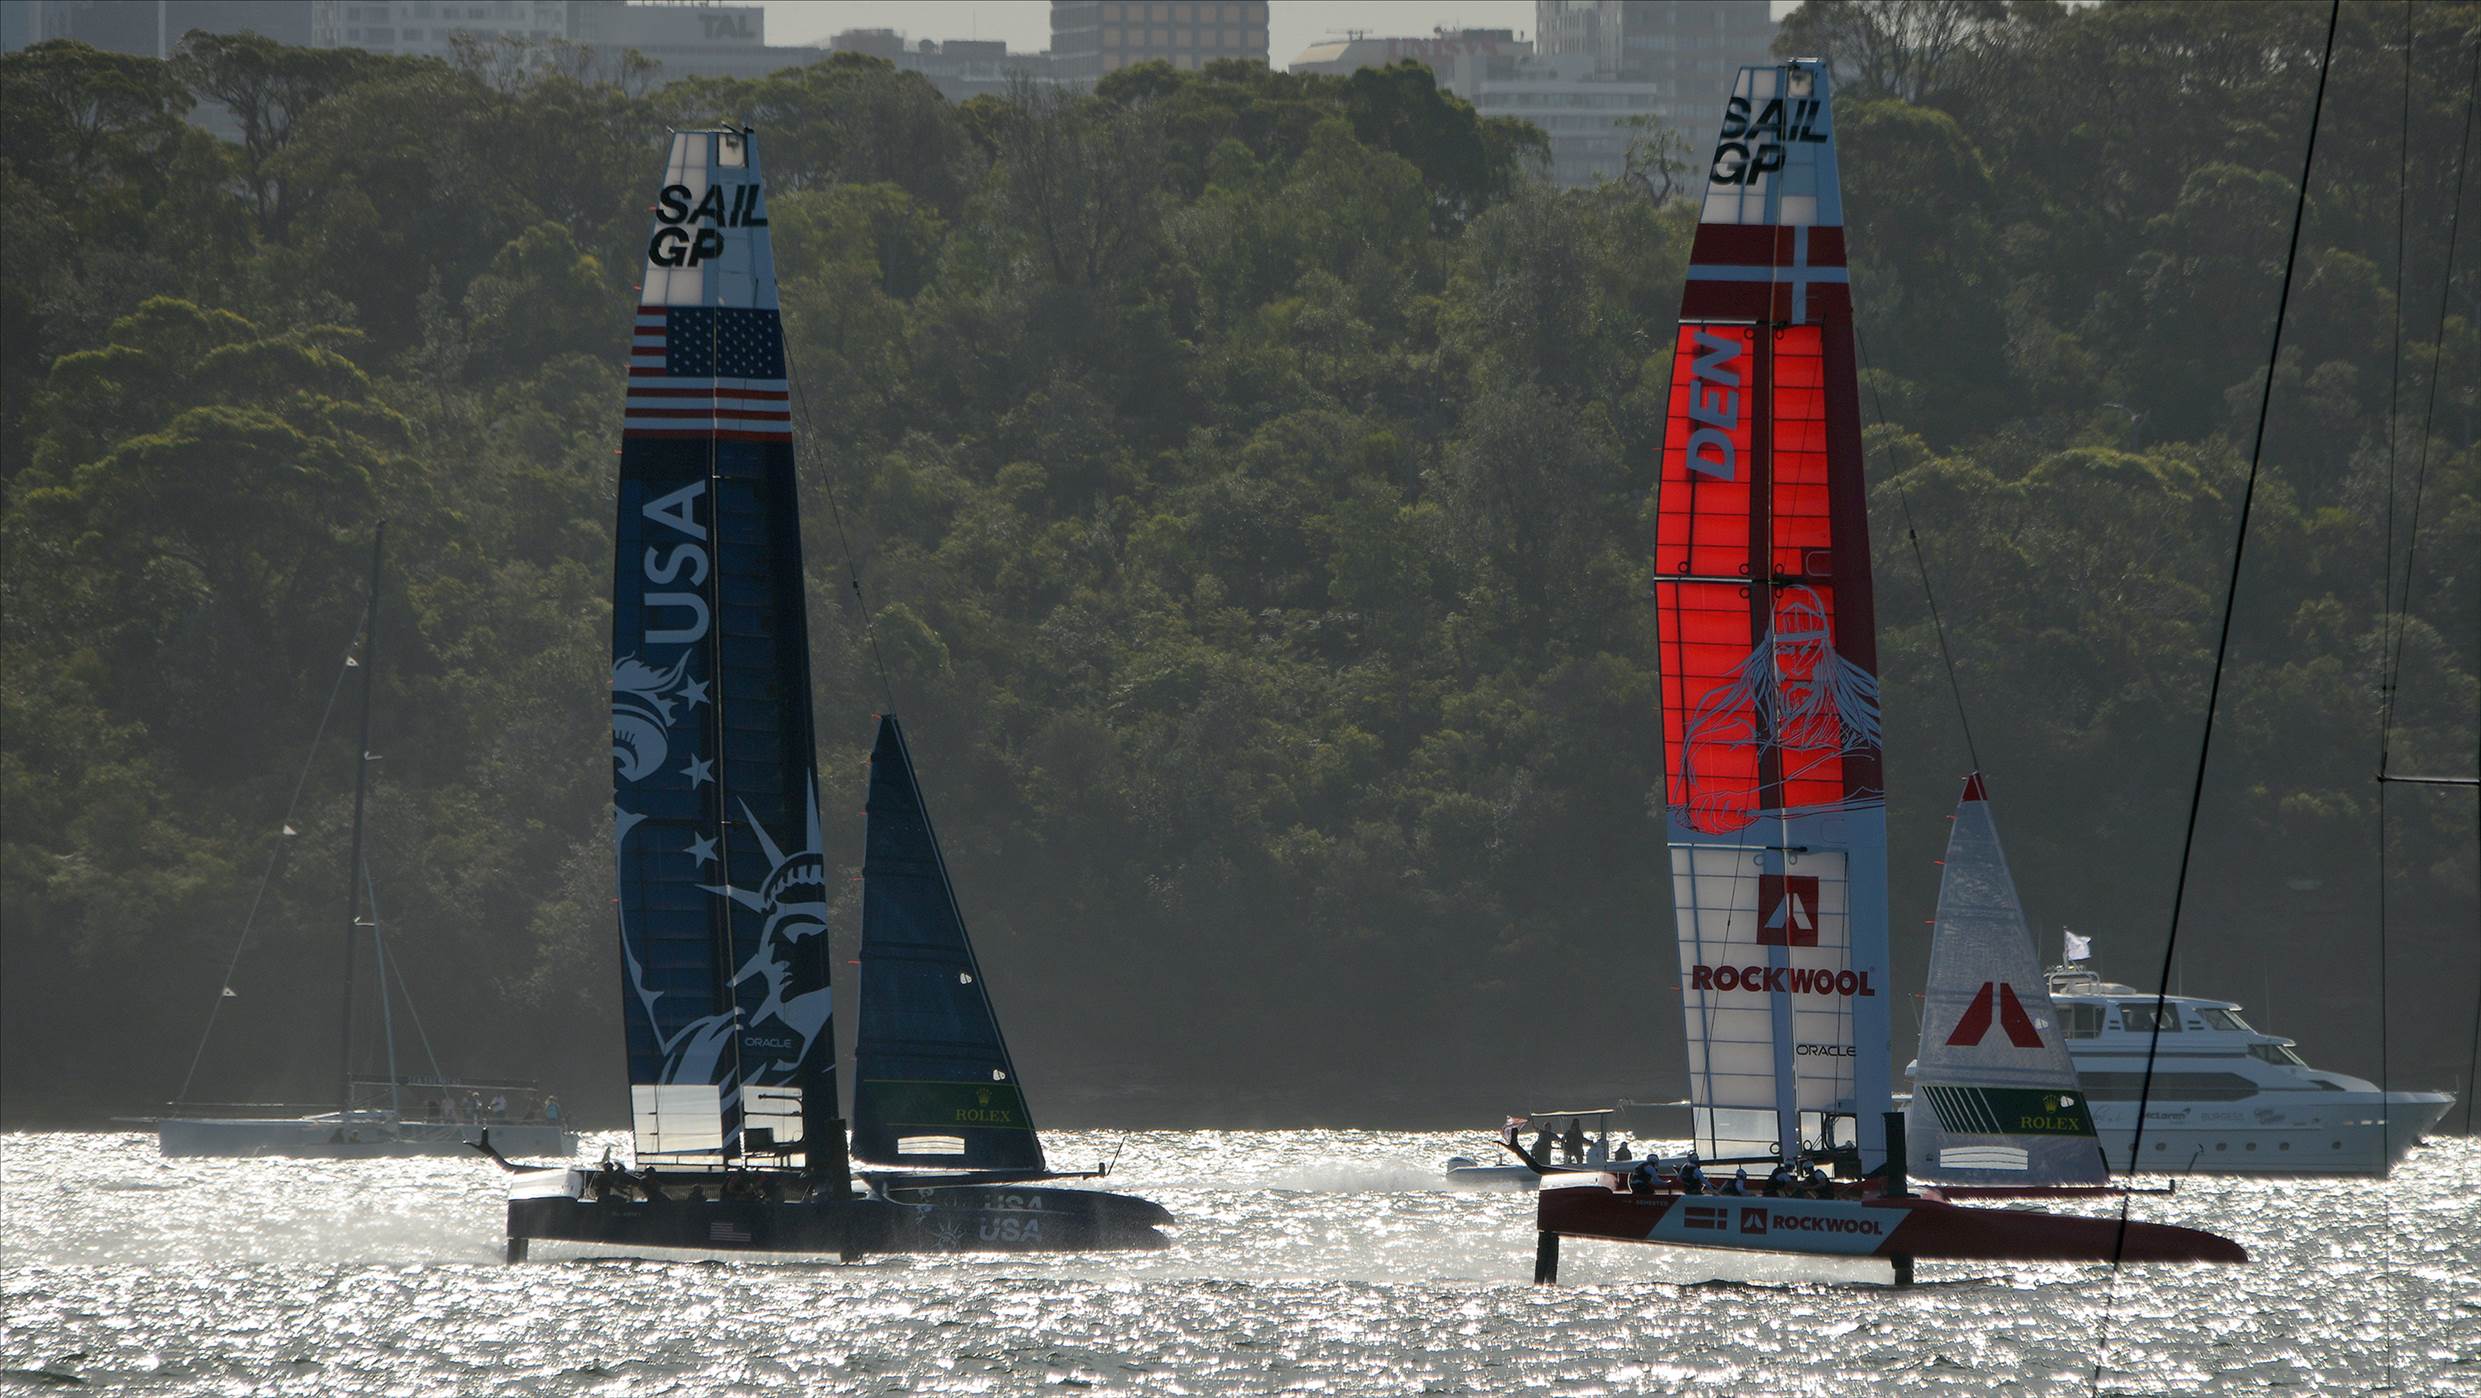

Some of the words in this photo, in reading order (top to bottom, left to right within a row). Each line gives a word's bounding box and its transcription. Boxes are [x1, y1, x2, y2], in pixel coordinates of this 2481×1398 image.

[698, 14, 756, 39] TAL
[1720, 97, 1828, 143] SAIL
[1709, 142, 1787, 186] GP
[656, 184, 768, 228] SAIL
[648, 226, 724, 267] GP
[1686, 330, 1742, 481] DEN
[642, 479, 711, 644] USA
[1692, 965, 1876, 997] ROCKWOOL
[744, 1037, 792, 1048] ORACLE
[1796, 1044, 1857, 1057] ORACLE
[955, 1108, 1011, 1122] ROLEX
[2020, 1115, 2080, 1131] ROLEX
[979, 1217, 1042, 1242] USA
[1772, 1215, 1883, 1235] ROCKWOOL
